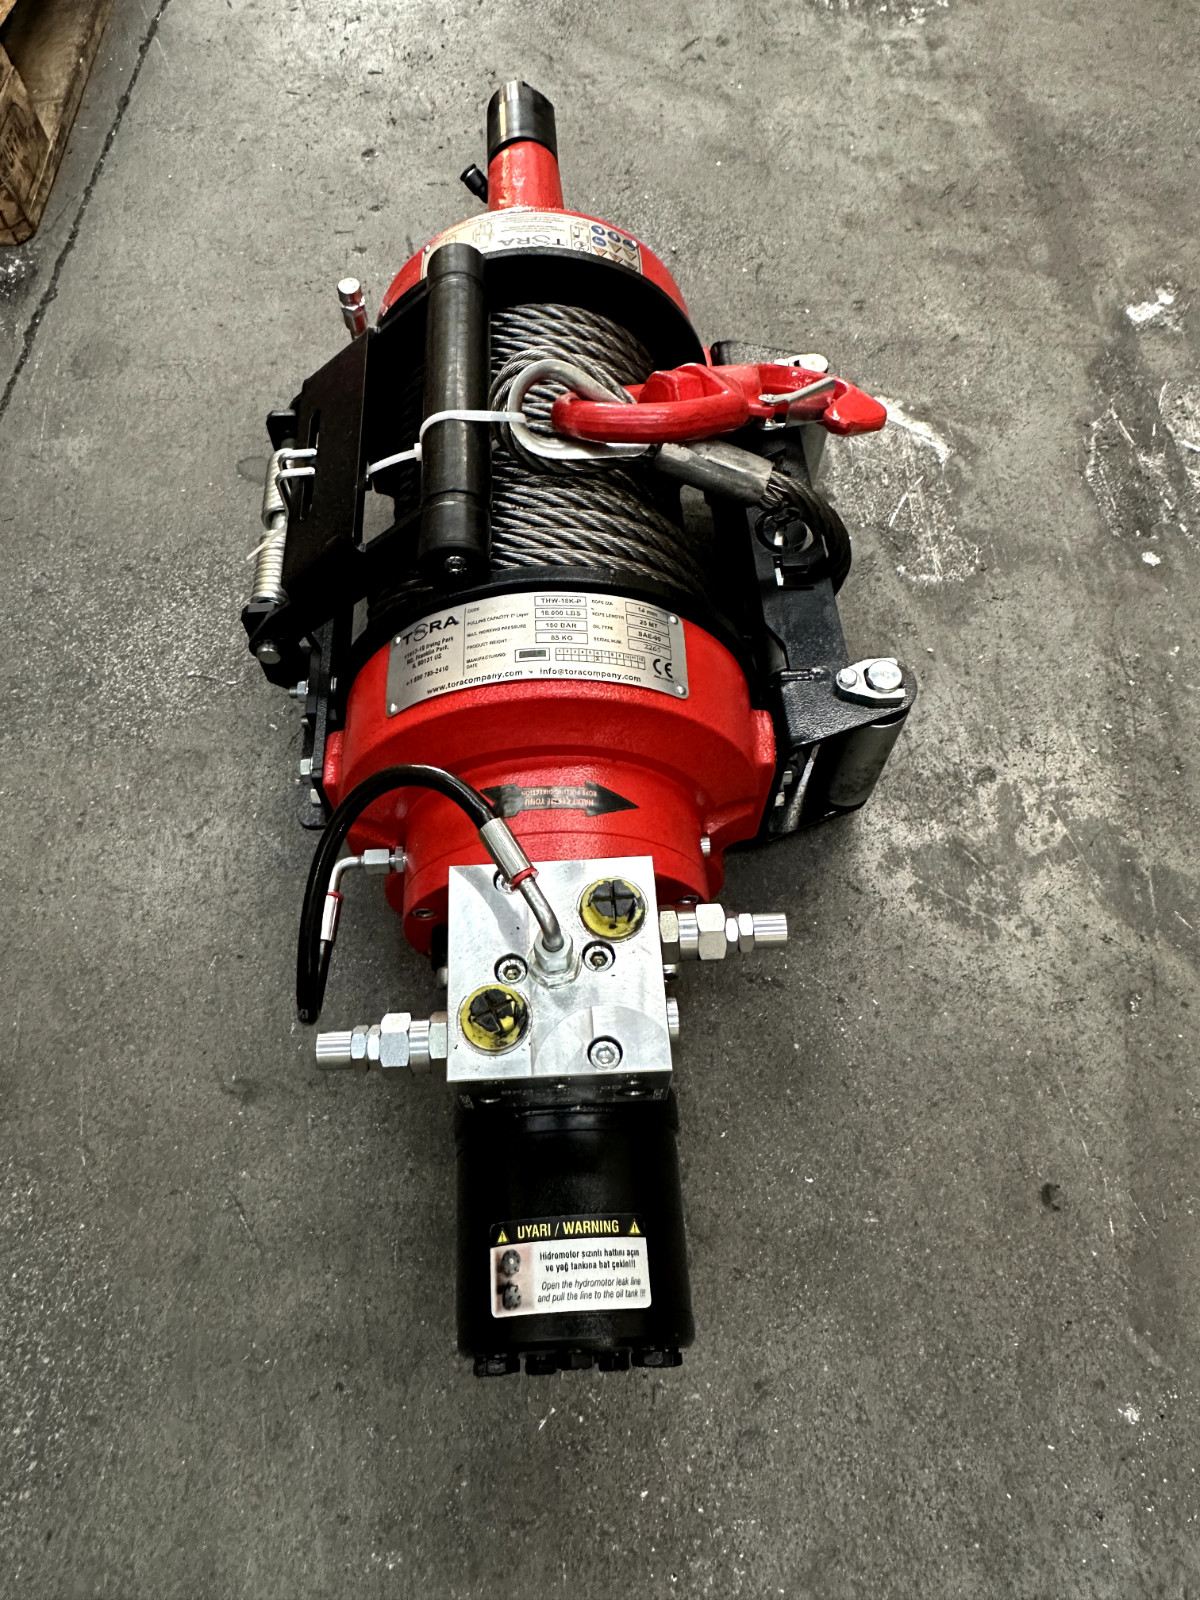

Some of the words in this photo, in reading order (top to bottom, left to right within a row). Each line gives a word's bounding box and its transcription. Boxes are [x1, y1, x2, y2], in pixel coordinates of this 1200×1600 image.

[498, 234, 565, 247] TORA
[487, 614, 510, 622] CAPACITY
[403, 616, 460, 645] TORA
[467, 641, 488, 650] PRODUCT
[466, 653, 506, 663] MANUFACTURING
[540, 667, 642, 682] info@toracompany.com
[427, 670, 523, 694] www.toracompany.com
[517, 1223, 551, 1239] UYARI
[555, 1222, 560, 1237] /
[563, 1219, 620, 1235] WARNING
[539, 1250, 579, 1261] Hidromotor
[627, 1249, 640, 1259] açın
[556, 1263, 569, 1273] yağ
[571, 1260, 597, 1270] tankına
[598, 1260, 610, 1269] hat
[542, 1281, 560, 1291] Open
[562, 1279, 573, 1289] the
[574, 1278, 614, 1290] hydromotor
[616, 1277, 629, 1286] leak
[631, 1277, 642, 1286] line
[537, 1294, 551, 1303] and
[552, 1291, 565, 1303] pull
[567, 1290, 578, 1300] the
[580, 1290, 593, 1300] line
[594, 1291, 602, 1299] to
[604, 1289, 614, 1298] the
[615, 1289, 624, 1298] oil
[625, 1288, 638, 1297] tank
